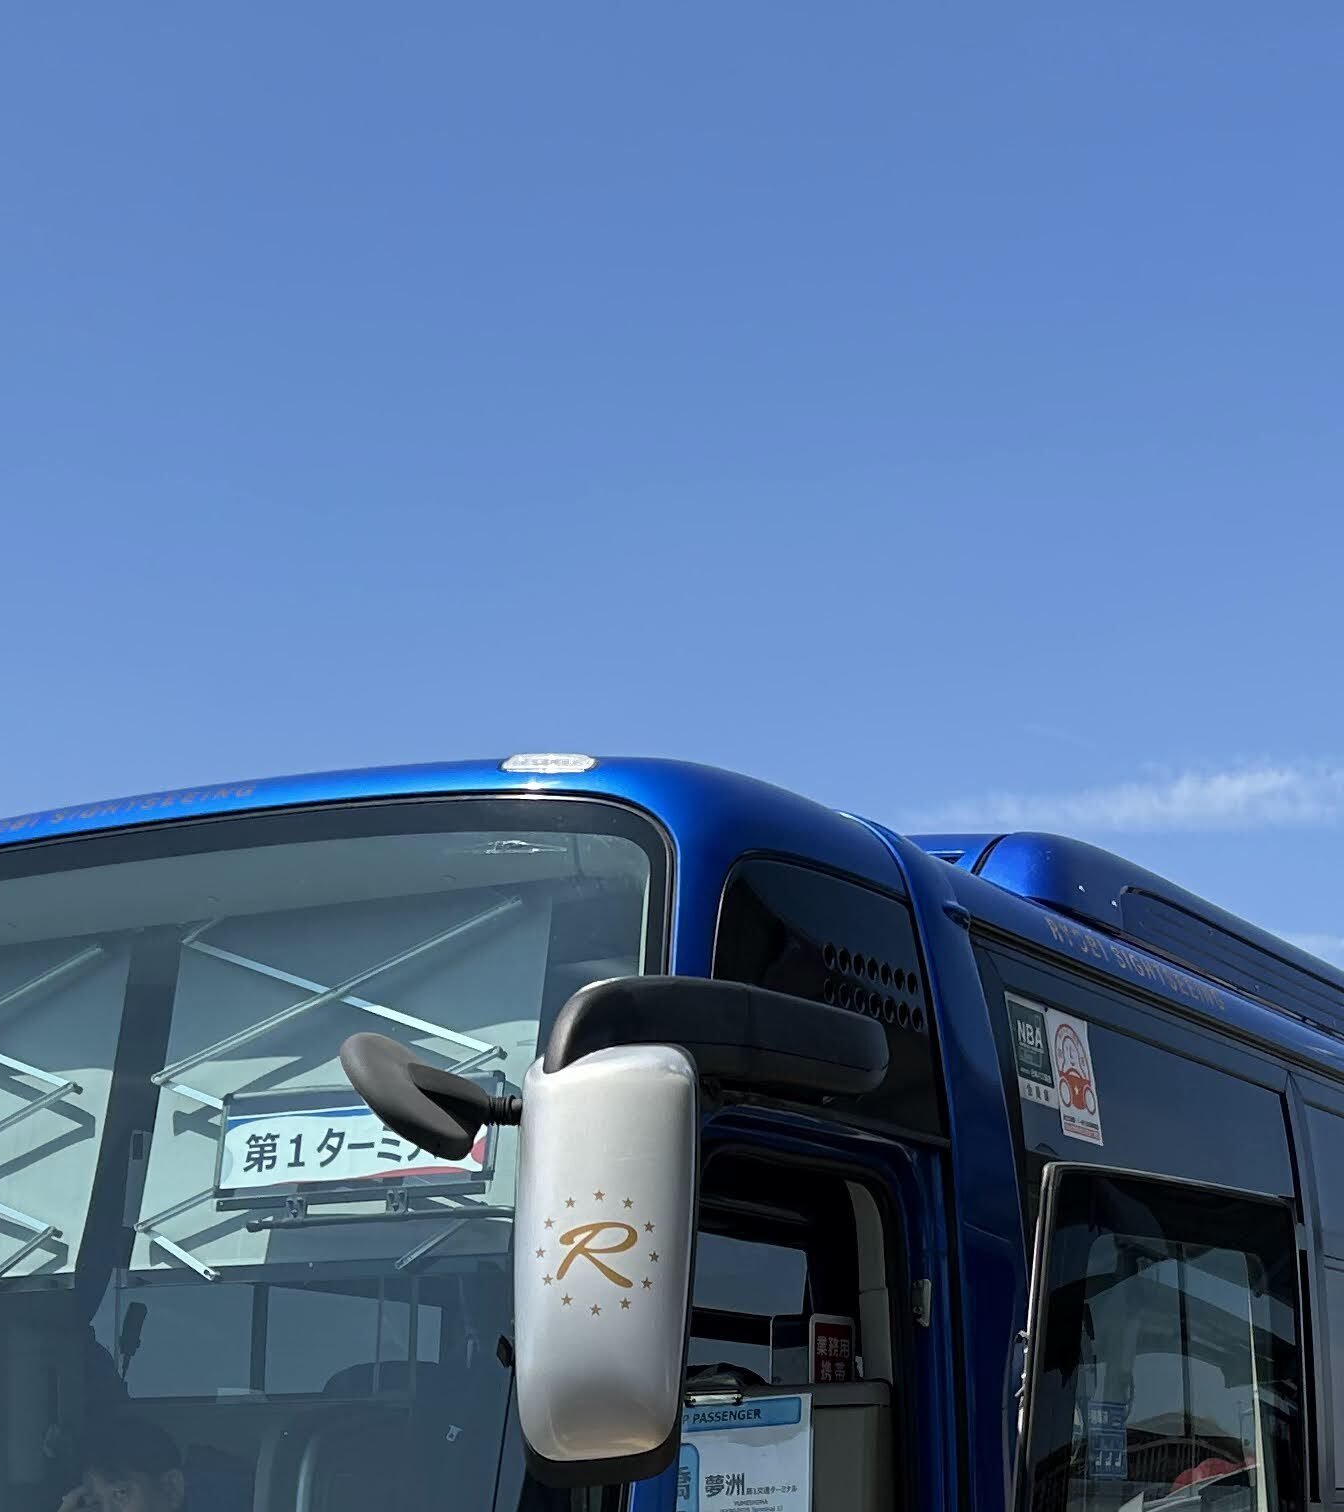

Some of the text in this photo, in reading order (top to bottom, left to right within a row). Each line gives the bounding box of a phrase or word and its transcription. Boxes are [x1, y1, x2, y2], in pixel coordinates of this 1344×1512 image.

[1017, 1020, 1044, 1048] NBA
[242, 1127, 438, 1173] 第1ターミ
[692, 1408, 762, 1425] PASSENGER
[705, 1473, 745, 1498] 夢洲
